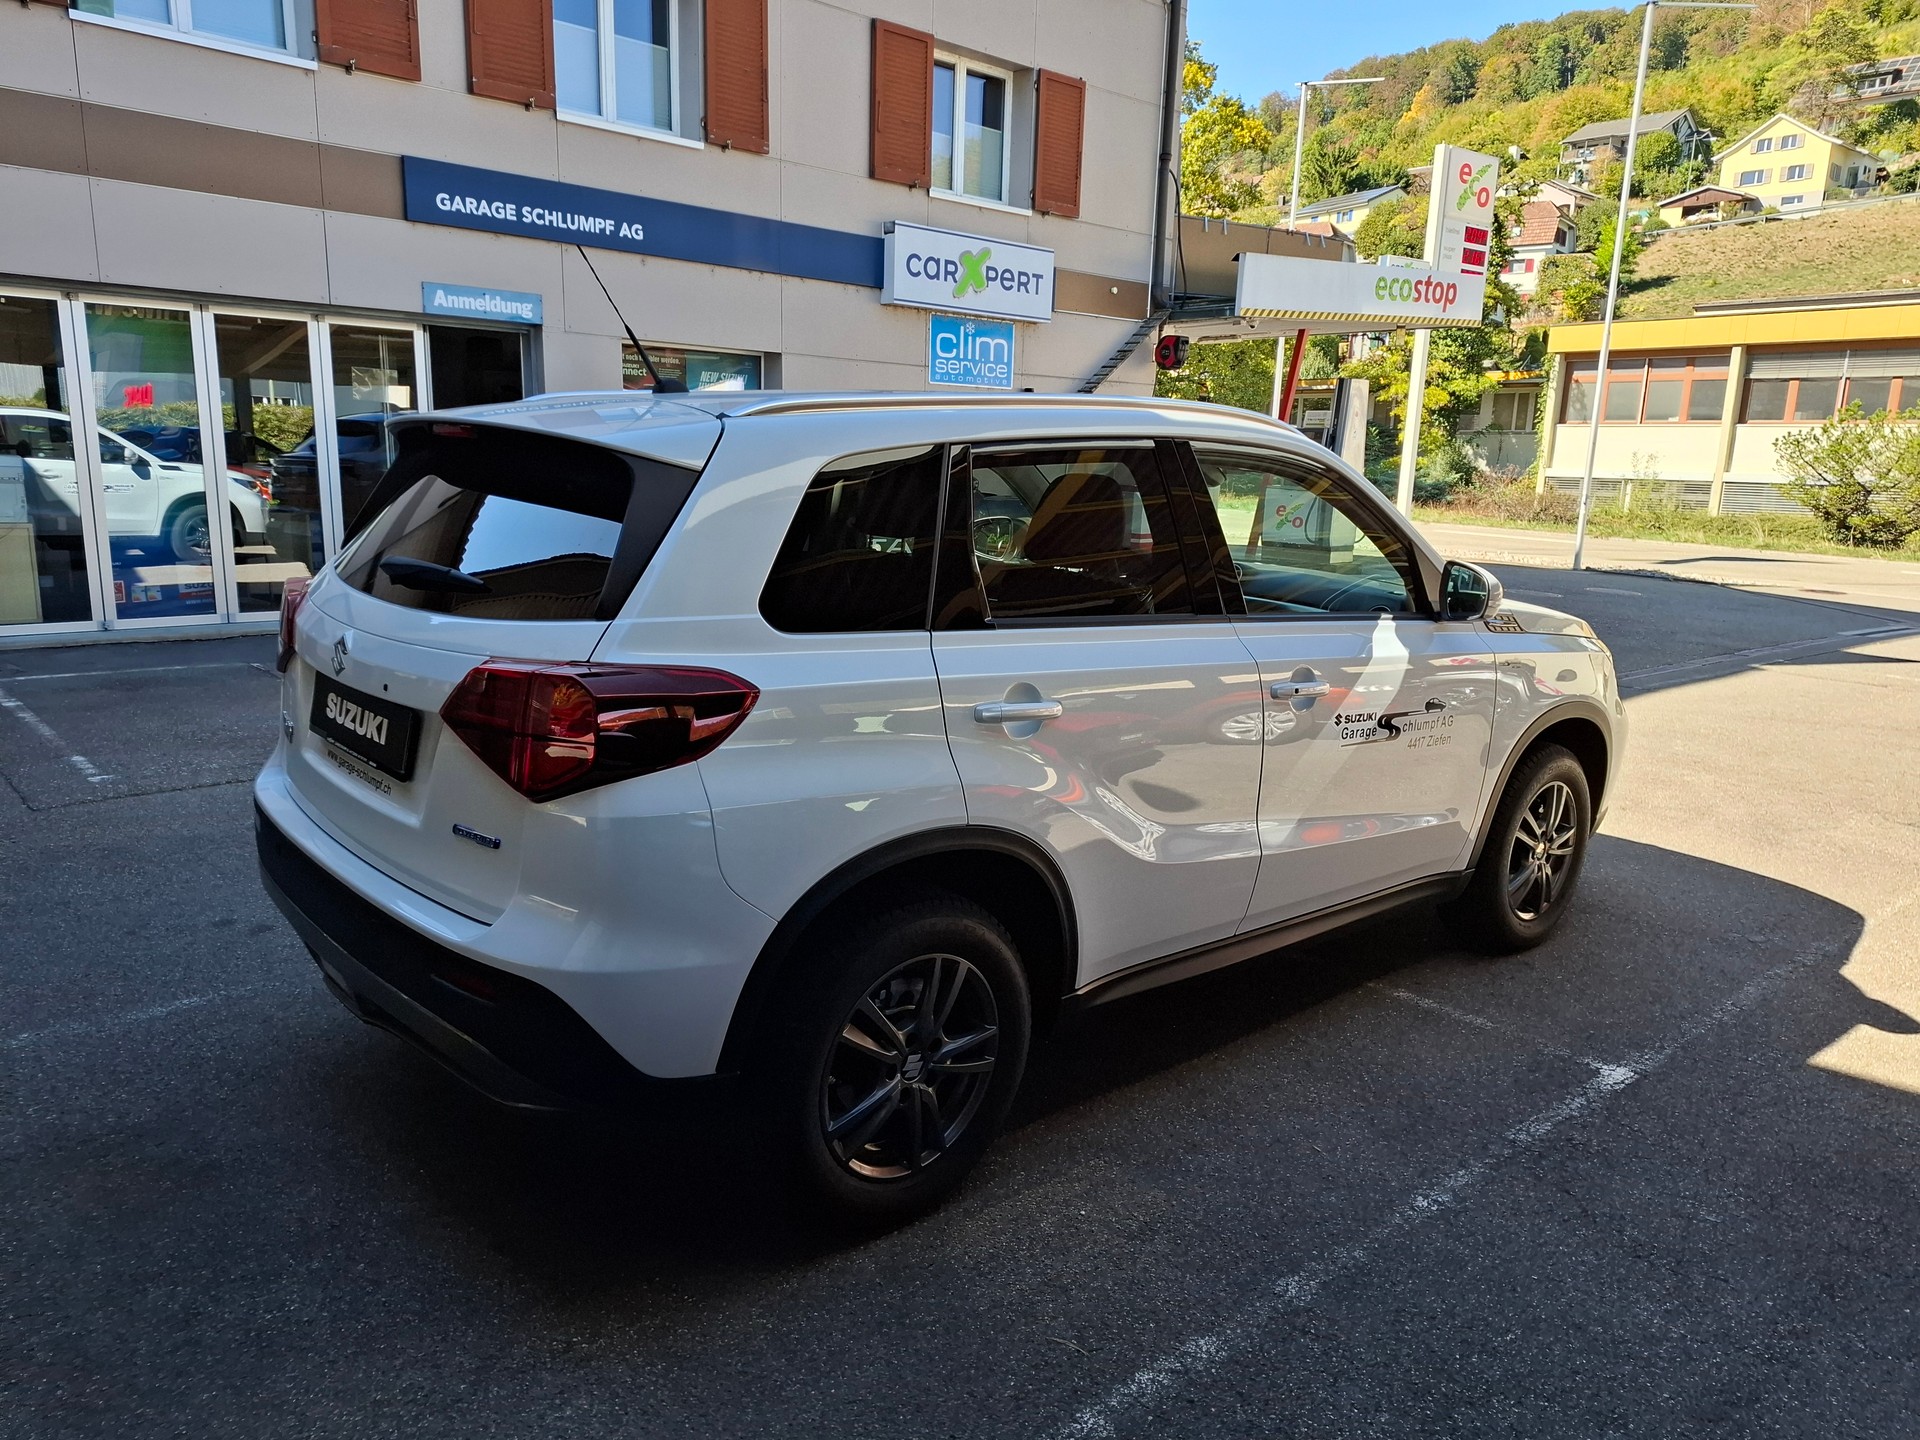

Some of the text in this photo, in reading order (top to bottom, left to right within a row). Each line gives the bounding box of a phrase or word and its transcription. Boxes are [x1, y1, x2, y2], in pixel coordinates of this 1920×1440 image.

[436, 192, 645, 240] GARAGE SCHLUMPF AG
[434, 289, 533, 318] Anmeldung
[1375, 274, 1458, 313] ecostop
[935, 325, 1009, 363] clim
[700, 370, 720, 383] NEW
[934, 373, 1008, 386] automotive
[935, 358, 1008, 378] service
[325, 692, 389, 746] SUZUKI
[1341, 726, 1378, 740] Garage
[1440, 715, 1454, 727] AG
[1344, 712, 1377, 724] SUZUKI
[1407, 735, 1452, 750] 4417 Ziefen
